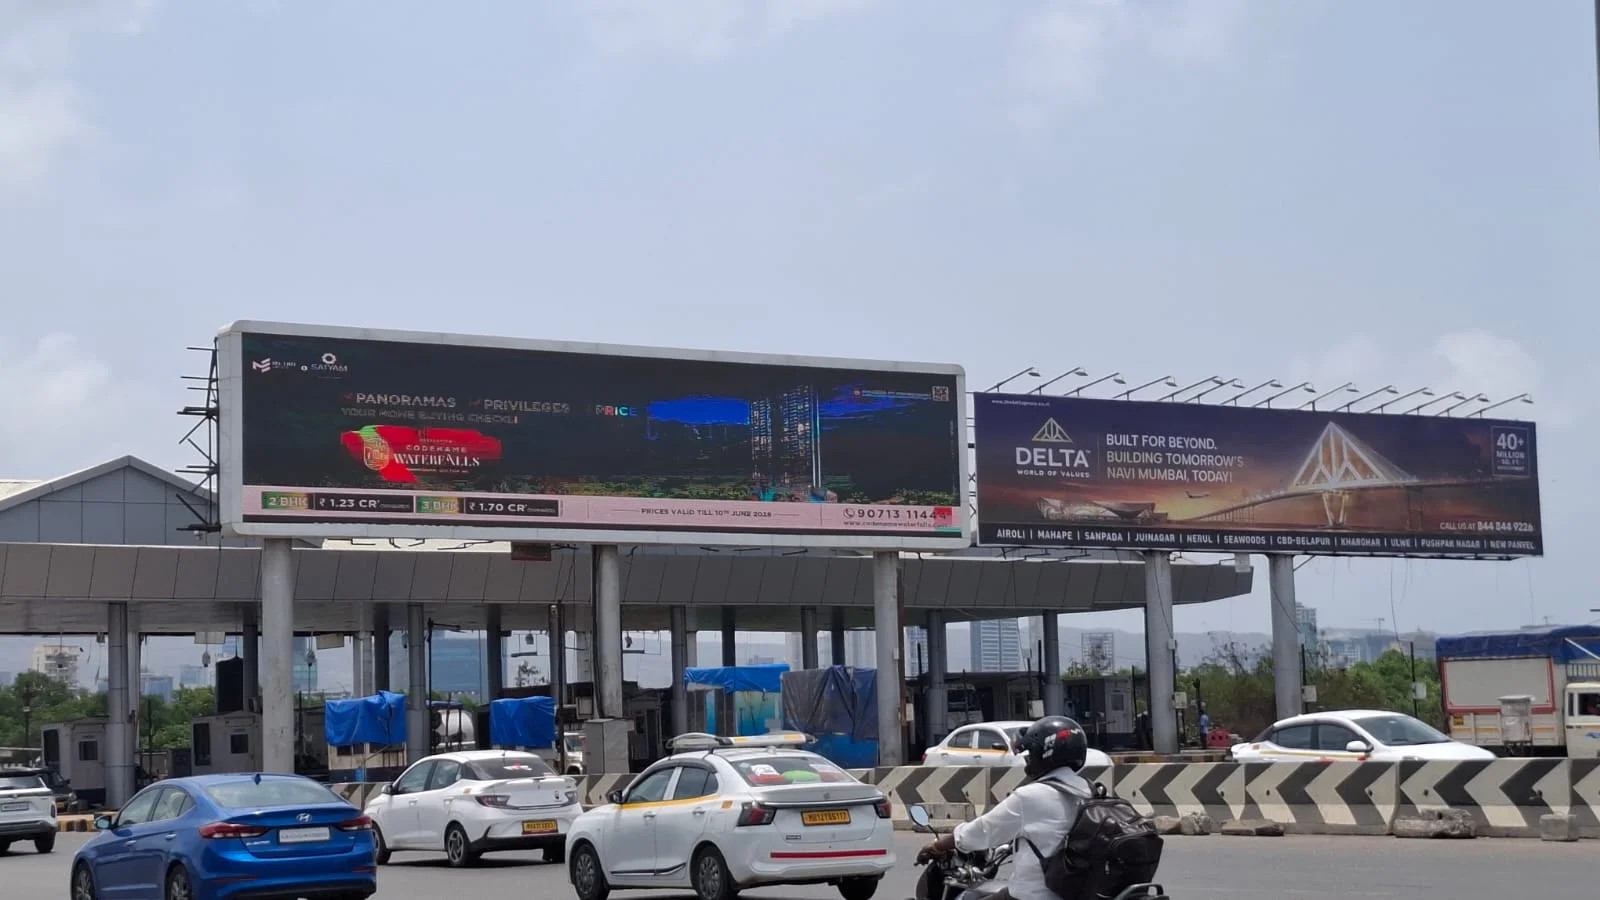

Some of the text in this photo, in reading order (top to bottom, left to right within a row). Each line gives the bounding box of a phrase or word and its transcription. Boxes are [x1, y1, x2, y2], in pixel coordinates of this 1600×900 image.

[311, 364, 348, 372] SATYAM
[356, 393, 456, 407] PANORAMAS
[484, 399, 570, 413] PRIVILEGES
[596, 405, 638, 416] PRICE
[341, 408, 376, 417] YOUR
[1106, 434, 1217, 450] BUILT FOR BEYOND.
[1497, 433, 1524, 450] 40+
[406, 445, 467, 453] CODENAME
[1496, 450, 1525, 459] MILLION
[393, 453, 480, 467] WATERFALLS
[1015, 447, 1089, 468] DELTA
[1107, 450, 1244, 468] BUILDING TOMORROW'S
[1017, 469, 1044, 477] WORLD
[1107, 467, 1233, 483] NAVI MUMBAI, TODAY!
[330, 498, 355, 508] 1.23
[479, 503, 504, 512] 1.70
[858, 509, 900, 519] 90713
[1440, 522, 1457, 530] CALL
[997, 528, 1025, 539] AIROLI
[1037, 530, 1073, 540] MAHAPE
[1084, 531, 1123, 542] SANPADA
[1135, 532, 1175, 543] JUINAGAR
[1186, 534, 1213, 544] NERUL
[1224, 535, 1266, 545] SEAWOODS
[1277, 536, 1330, 546] CBD-BELAPUR
[1391, 538, 1411, 548] ULWE
[1490, 540, 1506, 549] NEW
[1508, 540, 1536, 550] PANVEL
